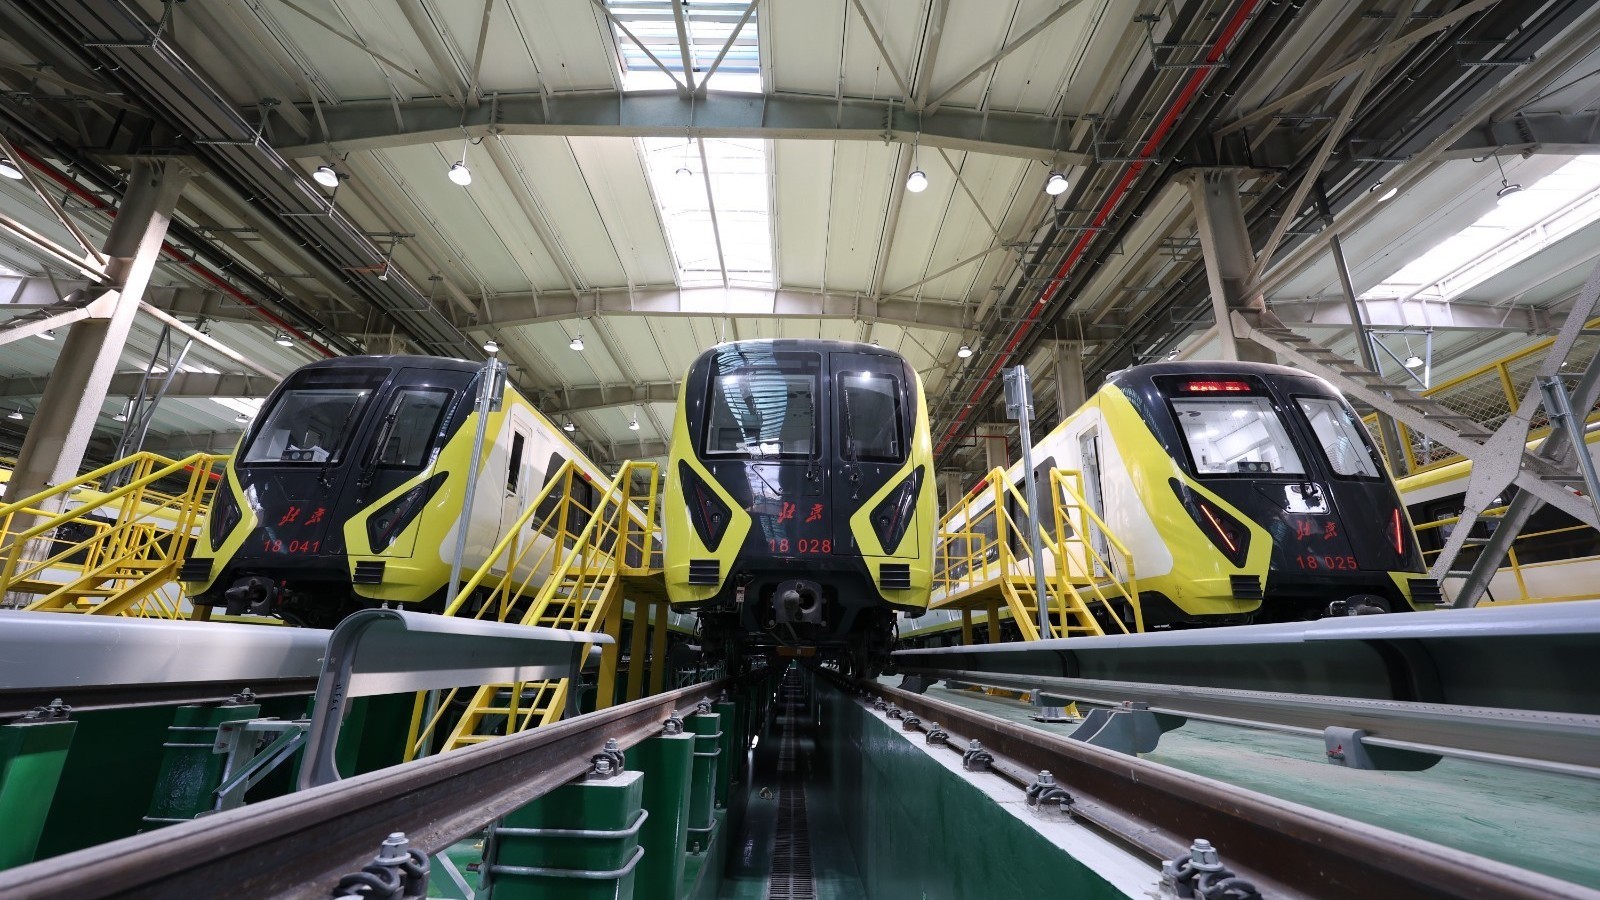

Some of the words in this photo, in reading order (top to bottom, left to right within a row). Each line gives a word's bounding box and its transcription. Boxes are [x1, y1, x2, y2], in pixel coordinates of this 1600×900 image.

[278, 506, 326, 526] 北京
[777, 502, 824, 523] 北京
[1297, 519, 1337, 540] 北京
